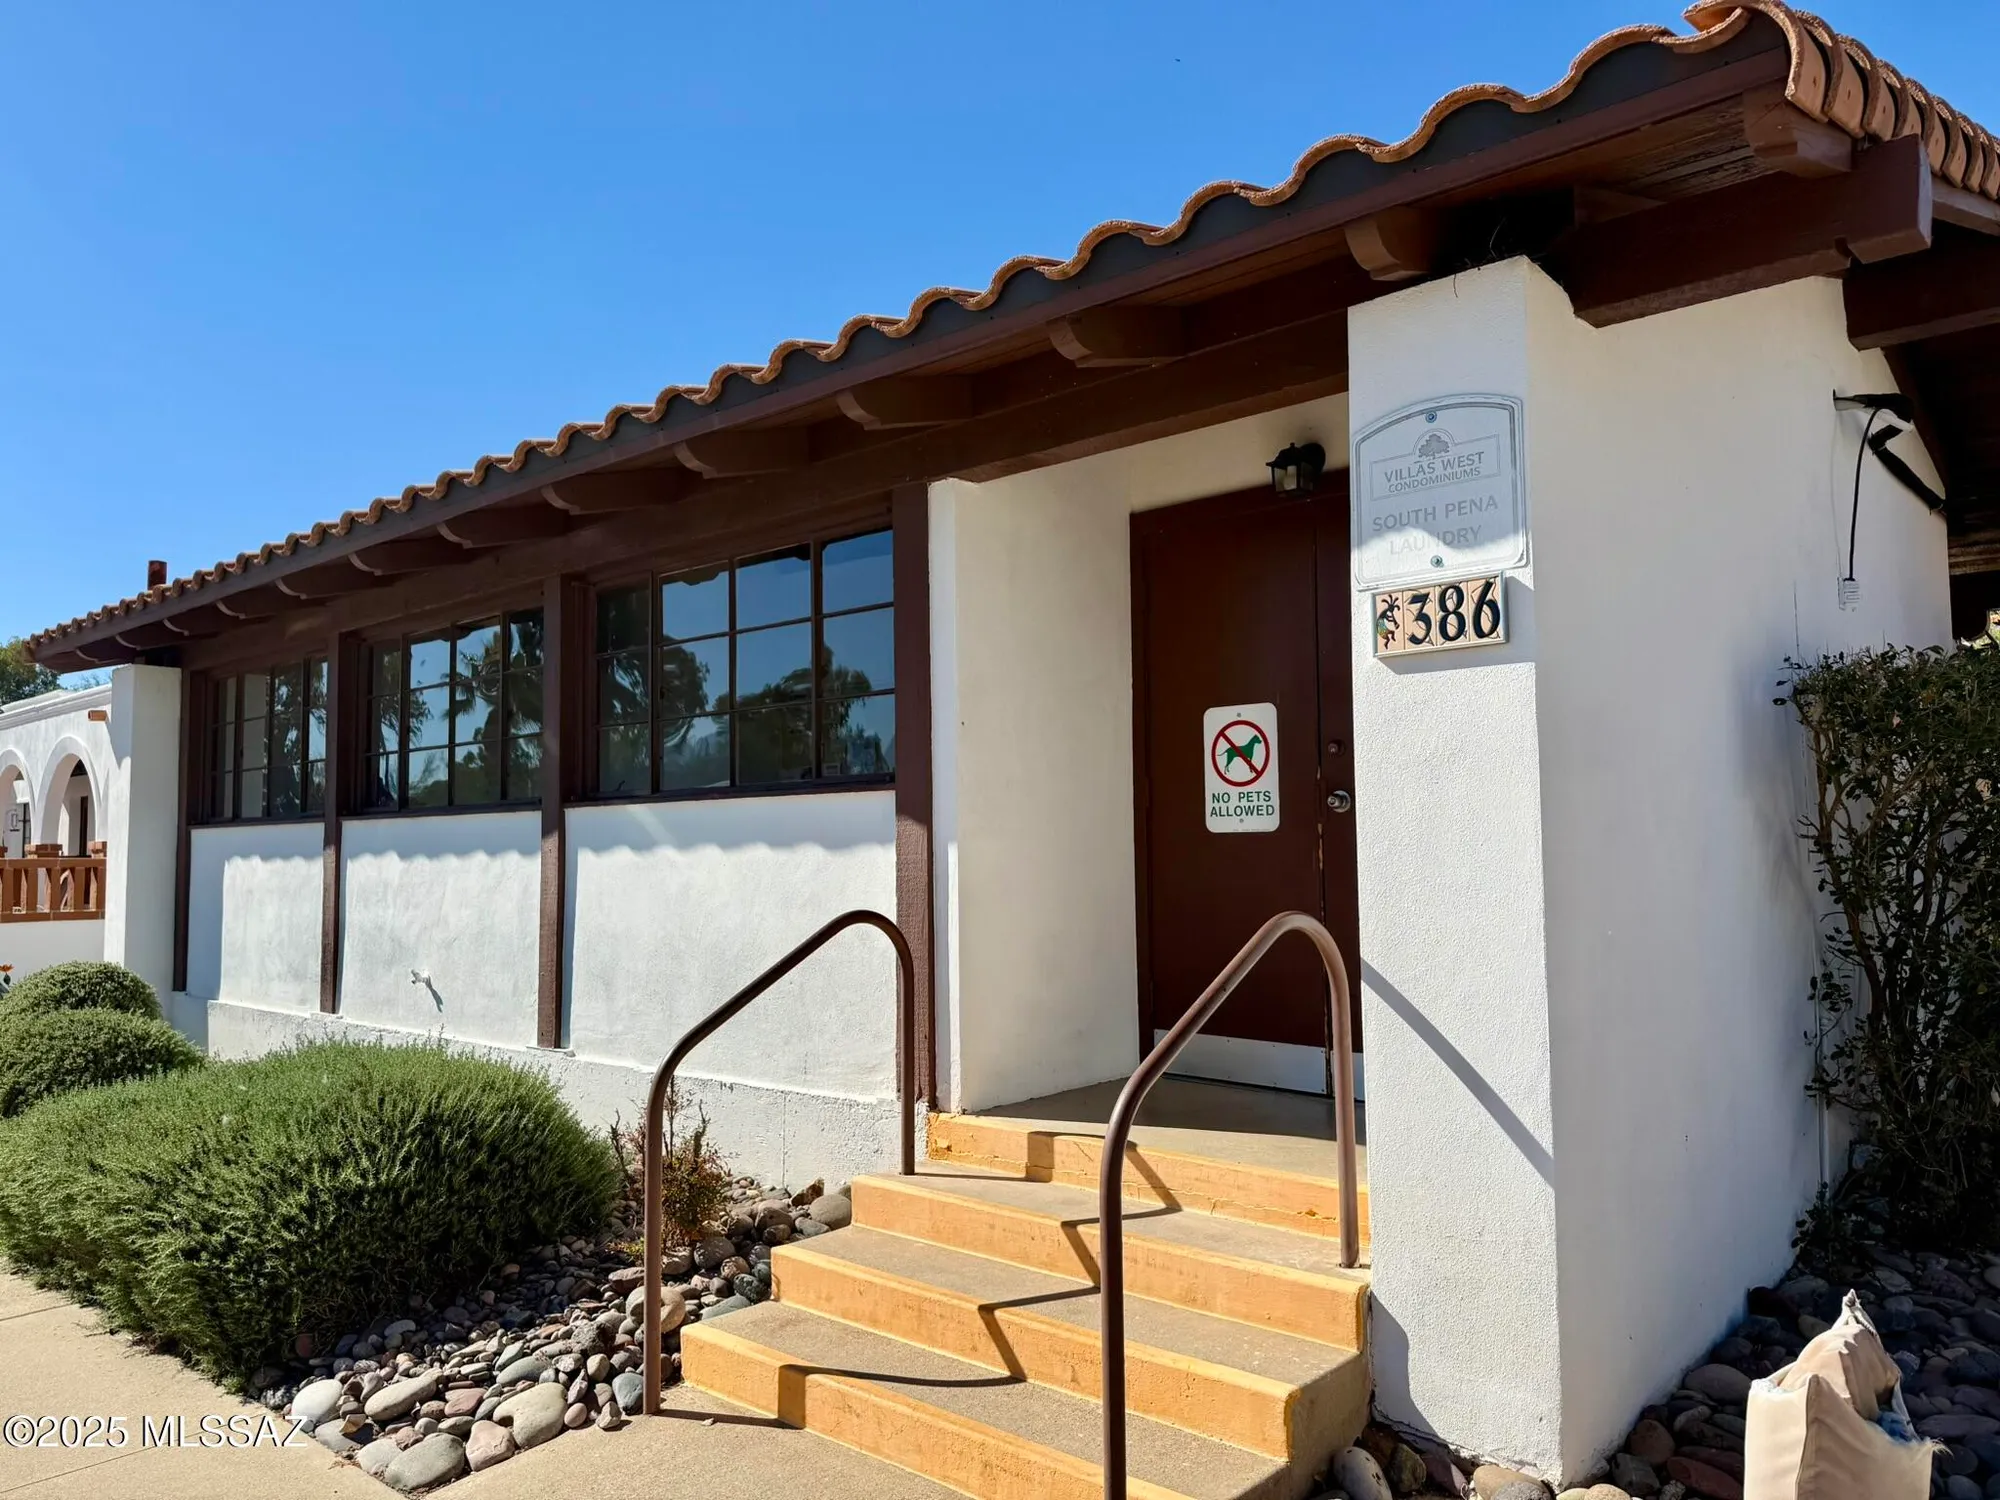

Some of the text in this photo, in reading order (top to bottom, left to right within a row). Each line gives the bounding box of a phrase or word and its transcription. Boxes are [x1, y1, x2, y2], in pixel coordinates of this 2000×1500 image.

[1384, 451, 1485, 483] VILLAS WEST
[1388, 466, 1481, 493] CONDOMINIUMS
[1372, 494, 1499, 532] SOUTH PENA
[1407, 579, 1501, 645] 386
[1210, 804, 1275, 817] ALLOWED
[1212, 790, 1272, 803] NO PETS
